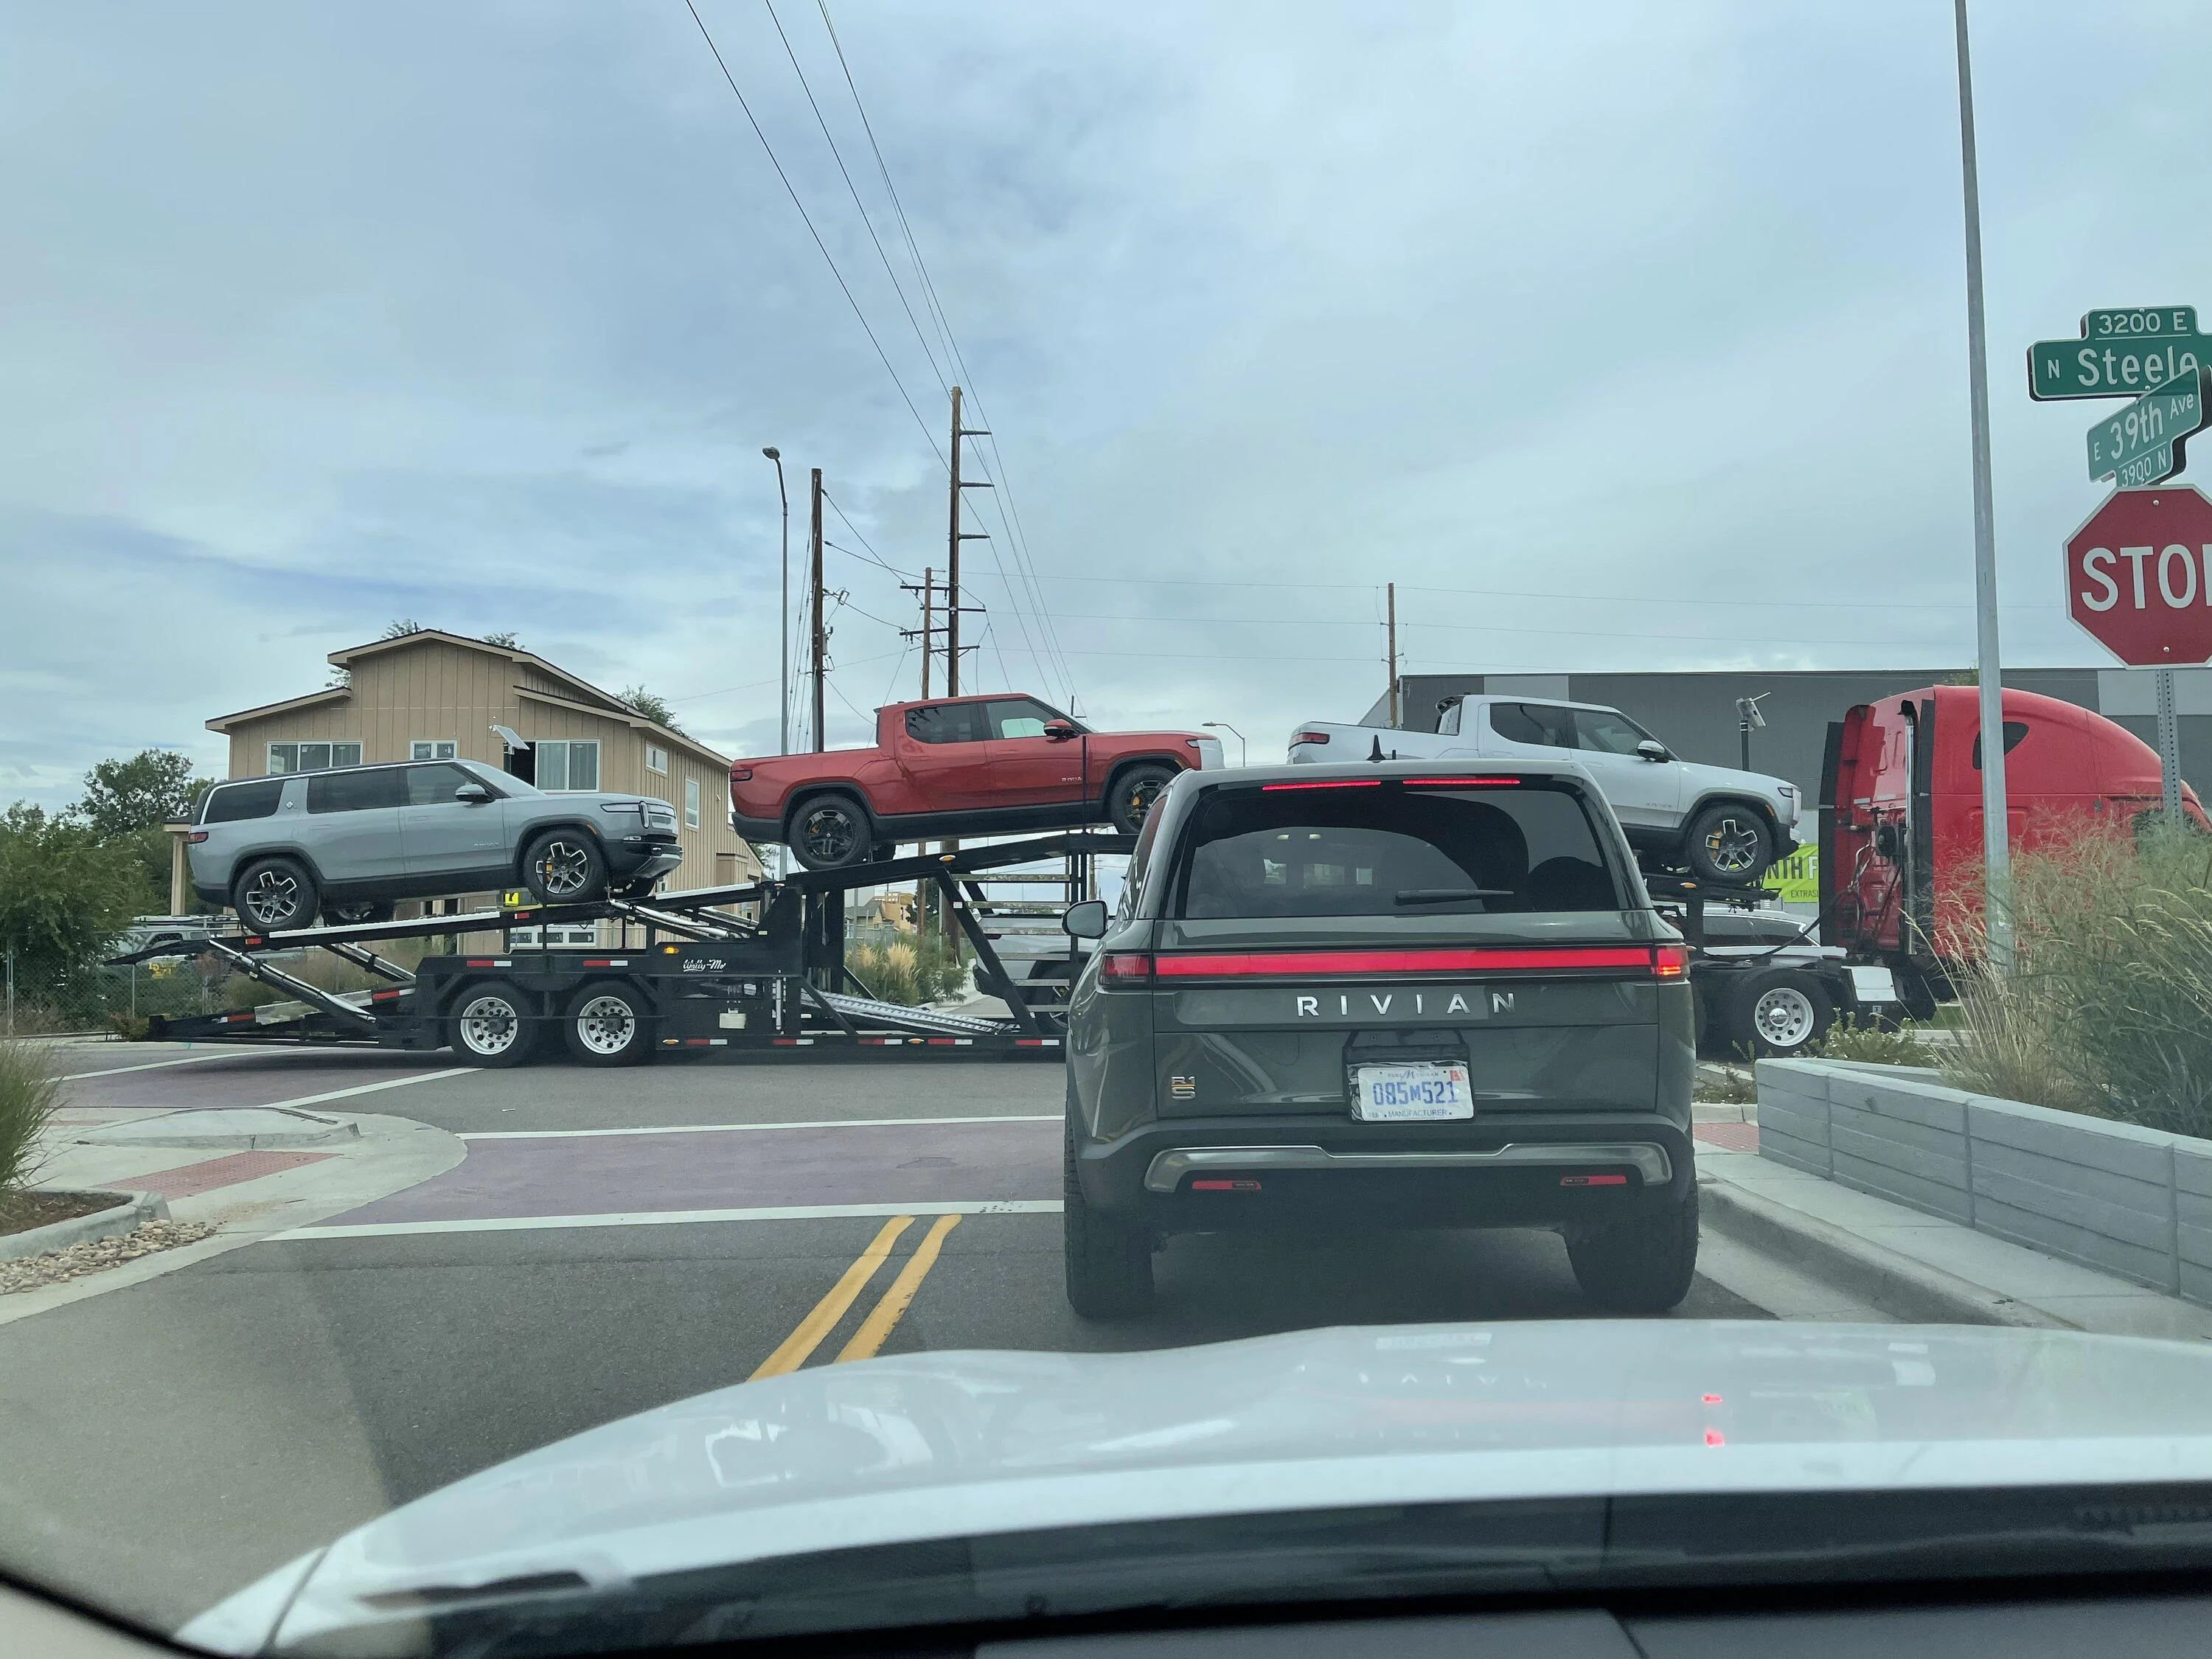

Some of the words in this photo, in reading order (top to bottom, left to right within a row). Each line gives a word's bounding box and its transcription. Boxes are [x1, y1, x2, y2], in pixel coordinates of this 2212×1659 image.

[2098, 313, 2160, 334] 3200
[2173, 311, 2188, 331] E
[2048, 359, 2060, 379] N
[2094, 442, 2101, 462] E
[2110, 401, 2163, 460] 39th
[2170, 393, 2194, 420] Ave
[2121, 457, 2152, 487] 3900
[2157, 449, 2167, 470] N
[1790, 890, 1819, 898] EXTRAS
[1296, 993, 1515, 1017] RIVIAN
[1373, 1081, 1458, 1105] 085M521
[1388, 1109, 1448, 1118] MANUFACTURER
